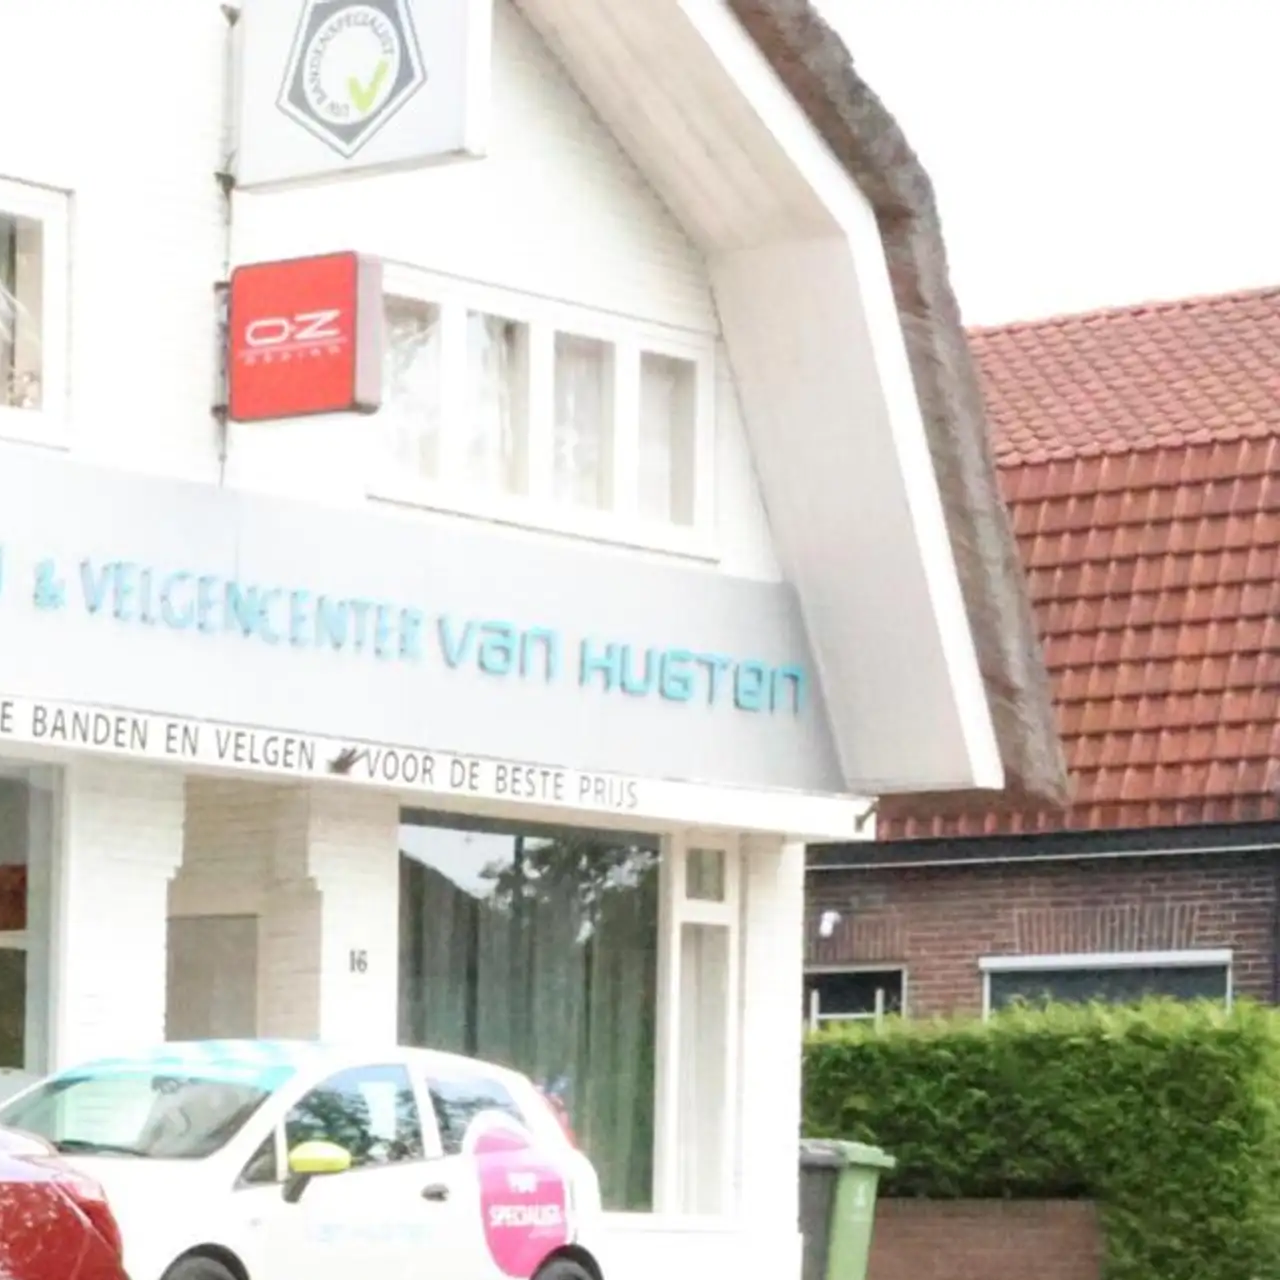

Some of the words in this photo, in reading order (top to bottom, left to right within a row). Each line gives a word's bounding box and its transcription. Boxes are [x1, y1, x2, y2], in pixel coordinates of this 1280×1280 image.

[32, 557, 66, 610] &
[31, 705, 149, 752] BANDEN
[165, 722, 200, 757] EN
[214, 728, 317, 771] VELGEN
[364, 748, 437, 786] VOOR
[449, 758, 481, 791] DE
[495, 766, 566, 802] BESTE
[578, 774, 640, 811] PRIJS
[348, 948, 369, 976] 16
